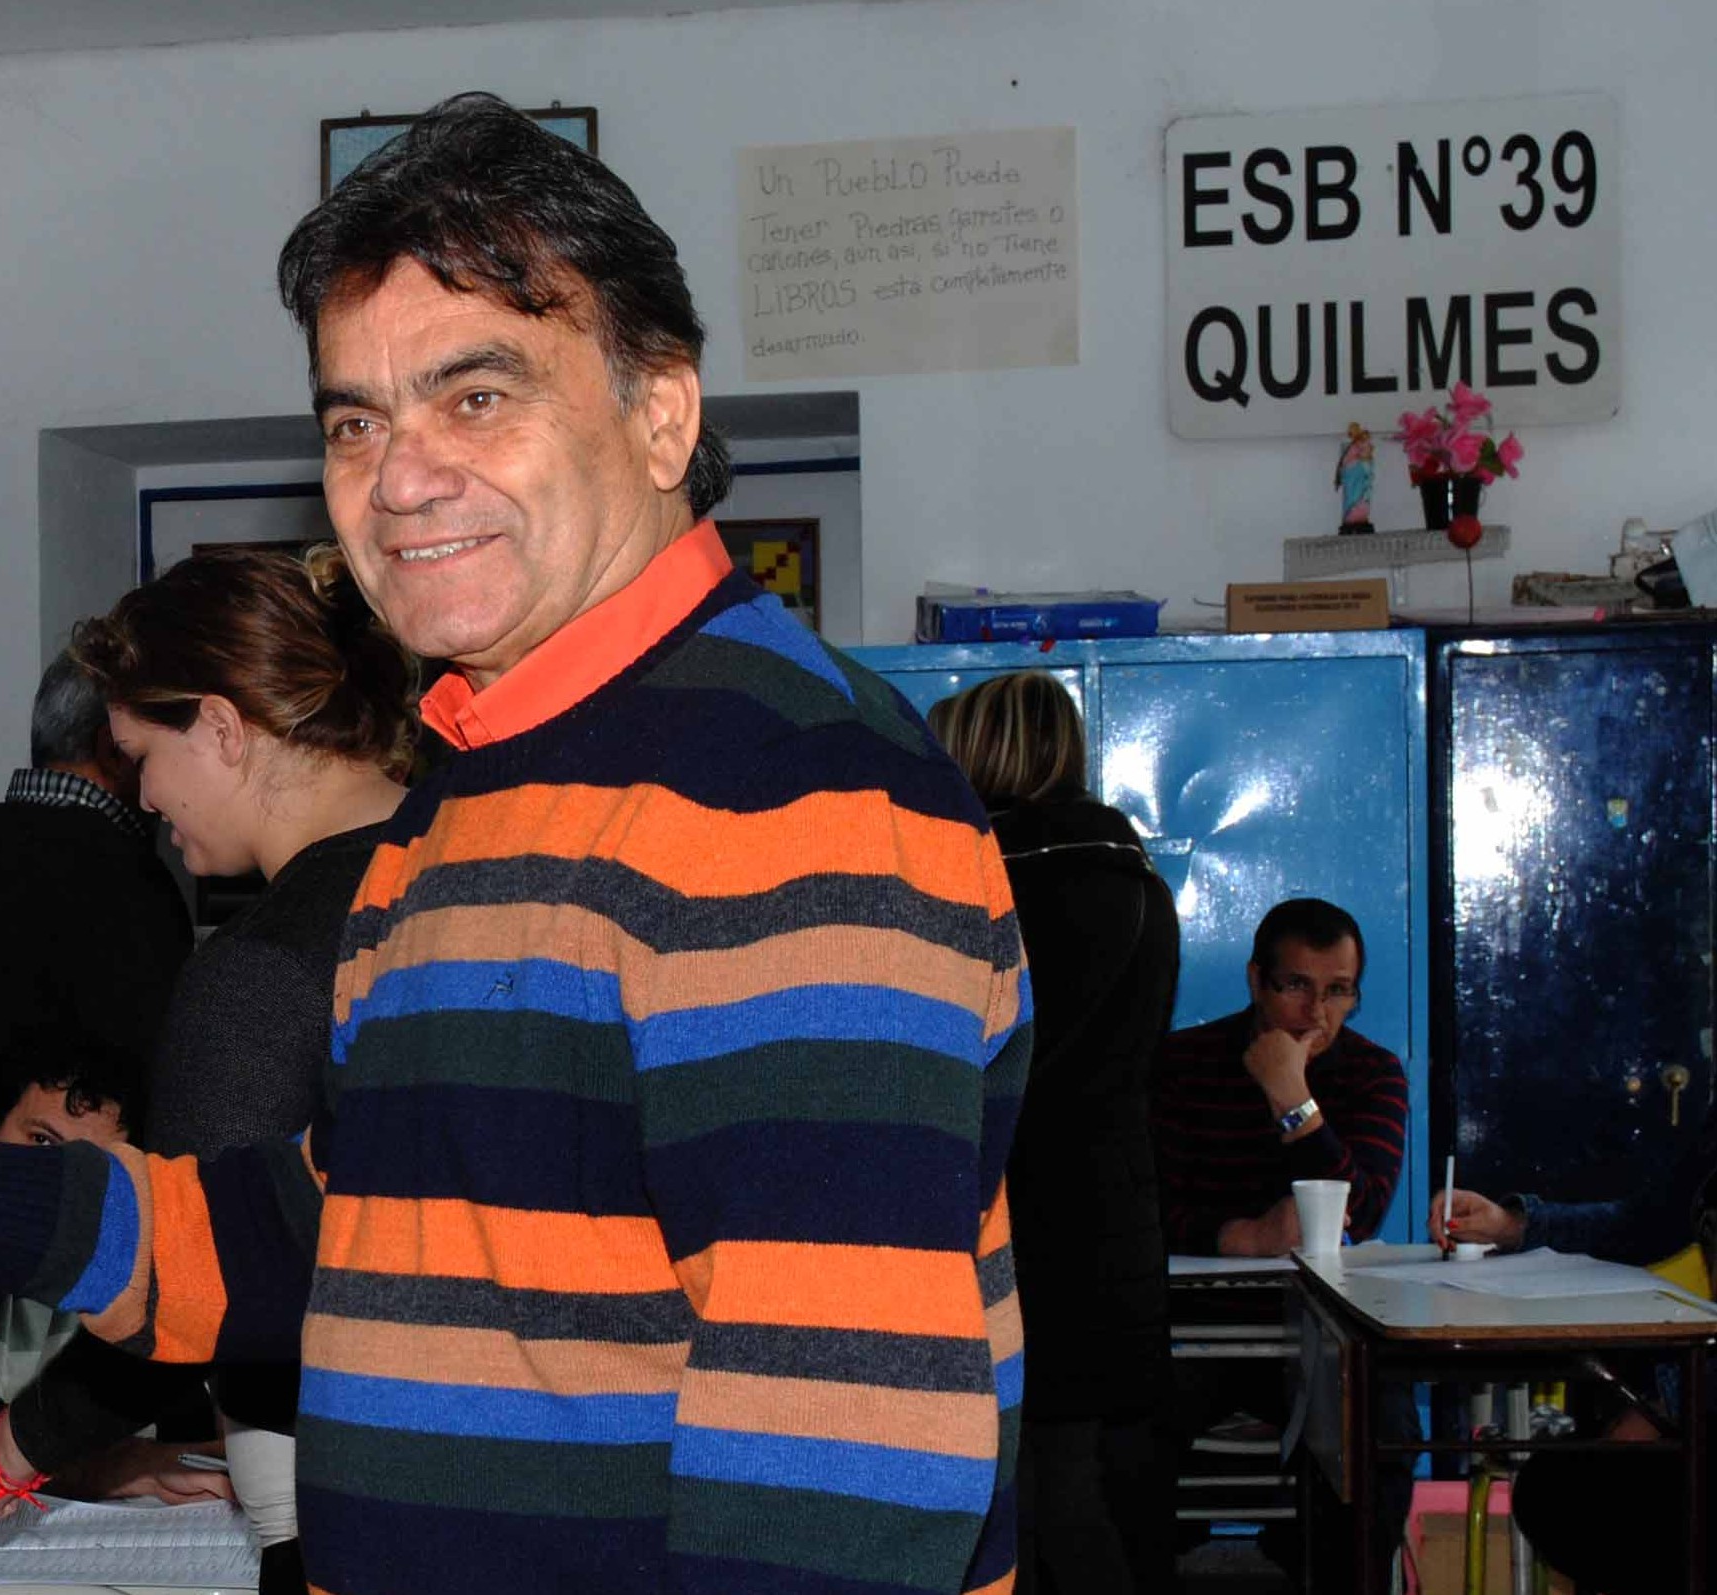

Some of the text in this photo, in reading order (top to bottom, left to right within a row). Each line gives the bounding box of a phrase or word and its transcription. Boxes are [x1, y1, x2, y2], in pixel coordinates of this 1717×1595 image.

[758, 164, 795, 197] Un
[1183, 145, 1361, 248] ESB
[1185, 287, 1601, 408] QUILMES
